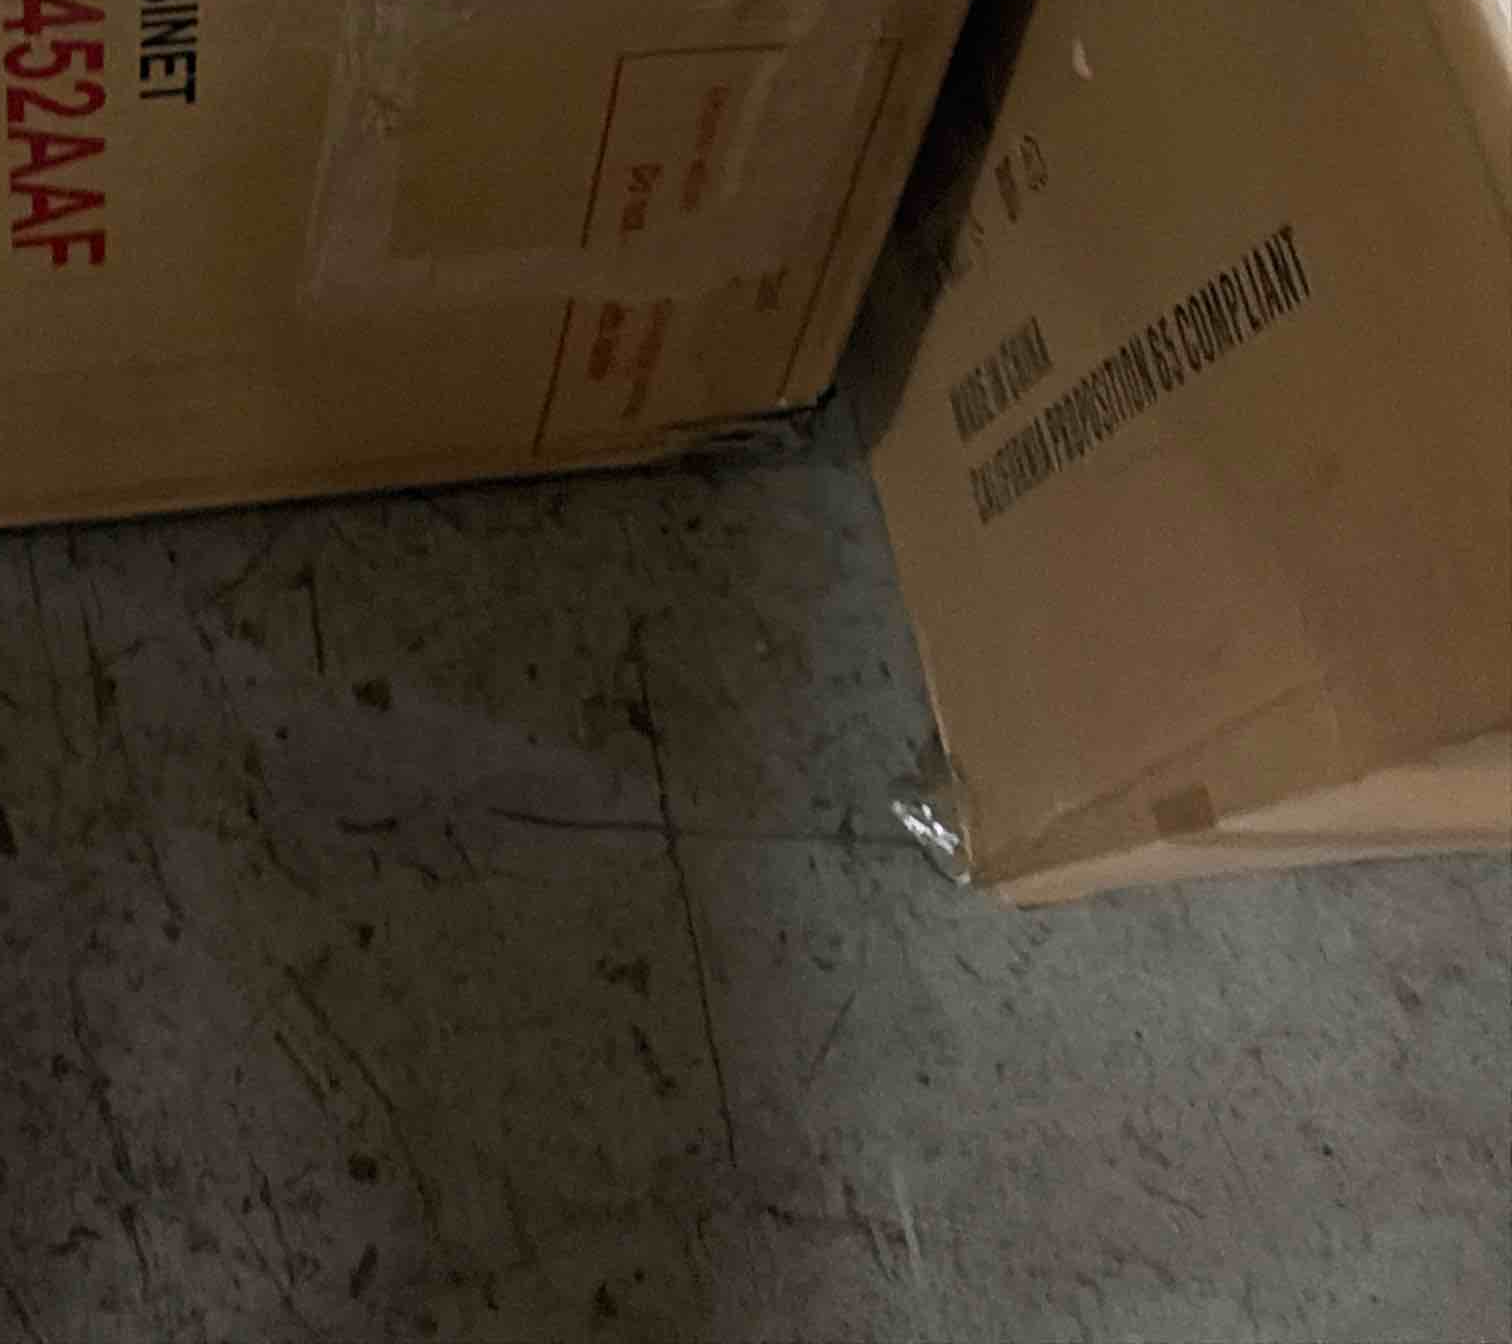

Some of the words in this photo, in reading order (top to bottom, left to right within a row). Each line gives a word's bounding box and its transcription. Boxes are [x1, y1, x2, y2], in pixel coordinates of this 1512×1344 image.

[1042, 332, 1159, 473] PROPOSITION
[1144, 315, 1187, 393] 65
[1173, 223, 1311, 375] COMPLIANT
